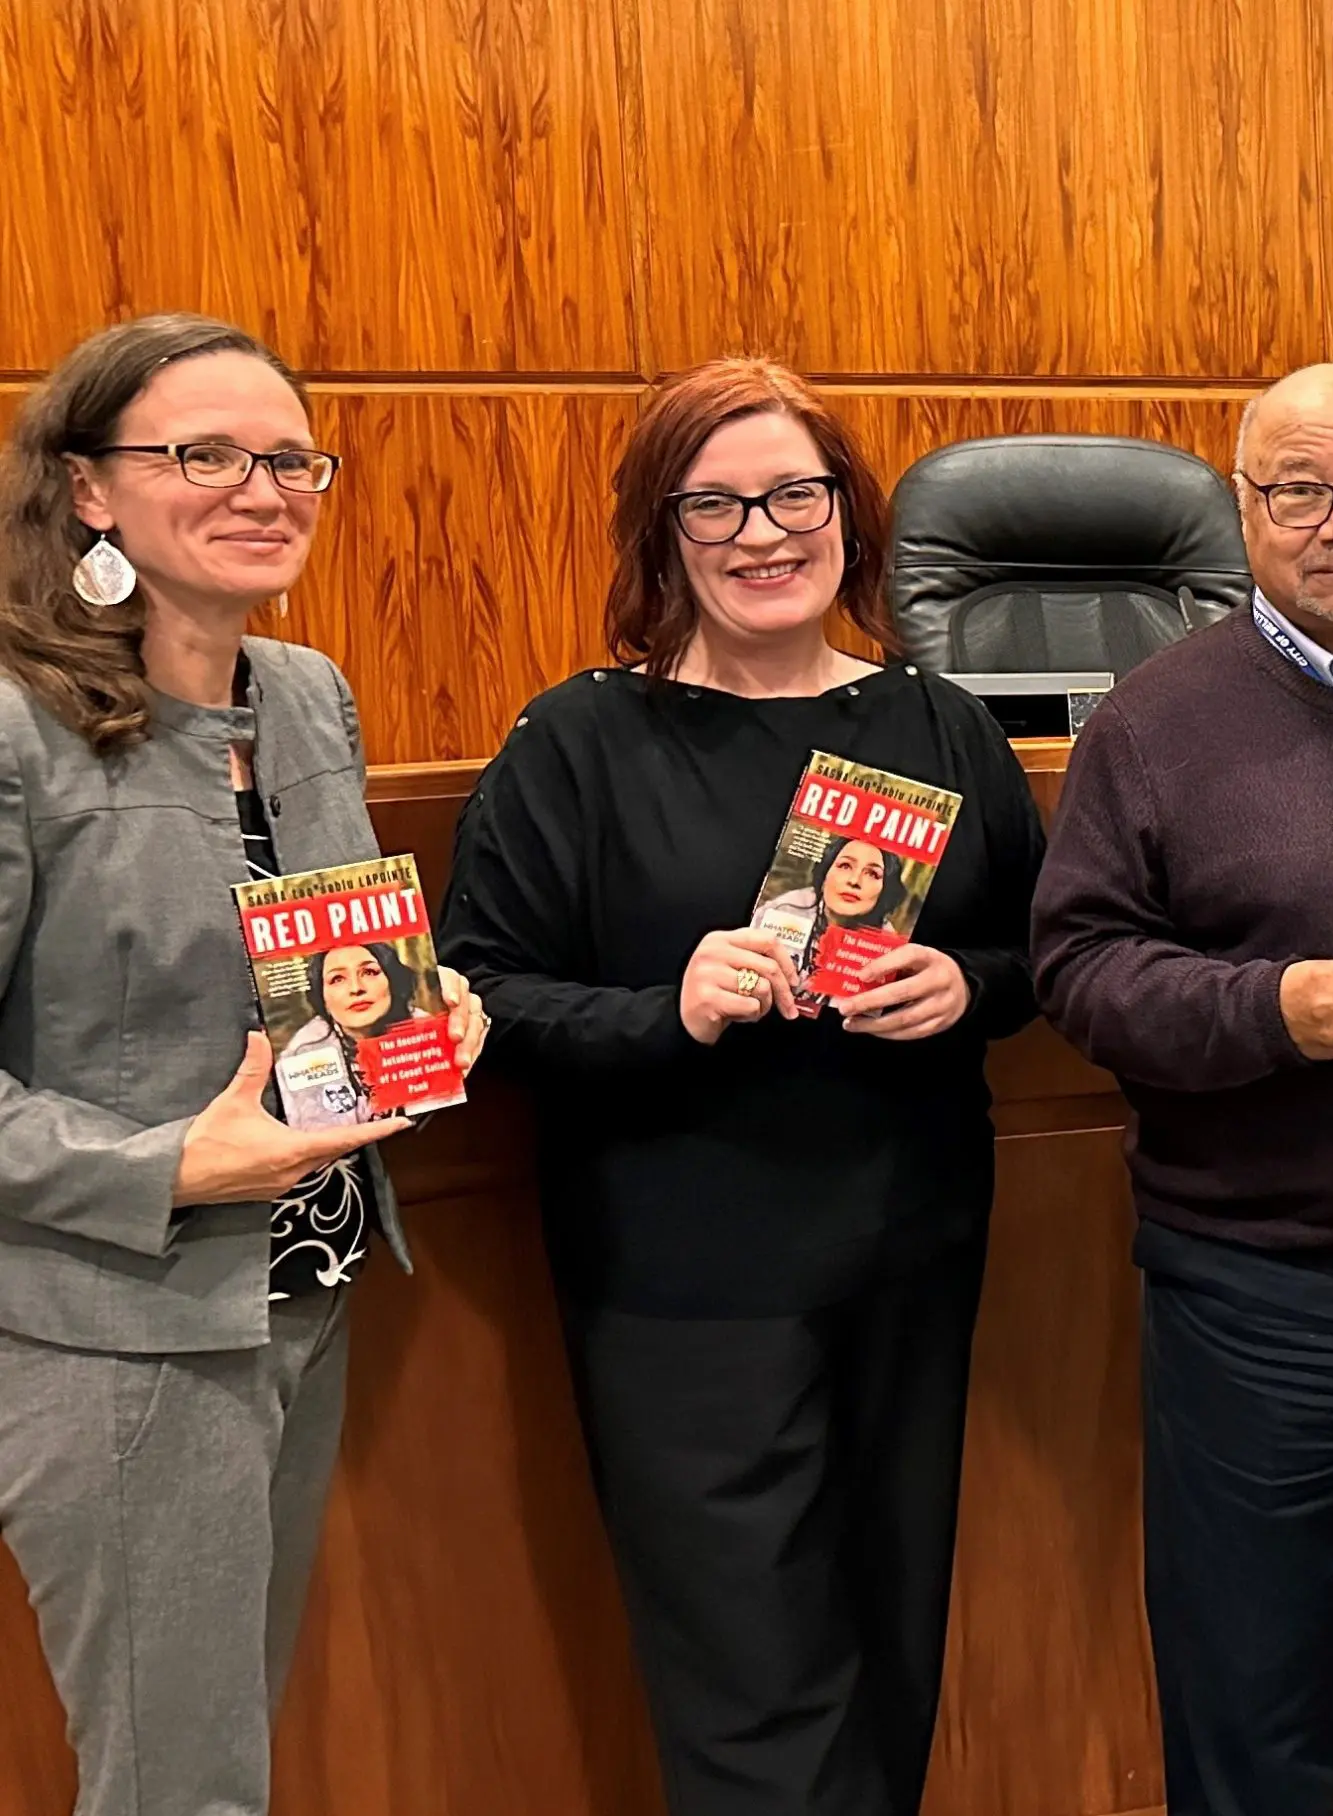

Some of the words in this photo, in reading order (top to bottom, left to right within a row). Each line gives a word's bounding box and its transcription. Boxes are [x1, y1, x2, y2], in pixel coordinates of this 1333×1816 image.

[800, 783, 860, 826] RED
[863, 803, 948, 854] PAINT
[250, 908, 316, 953] RED
[327, 888, 418, 938] PAINT
